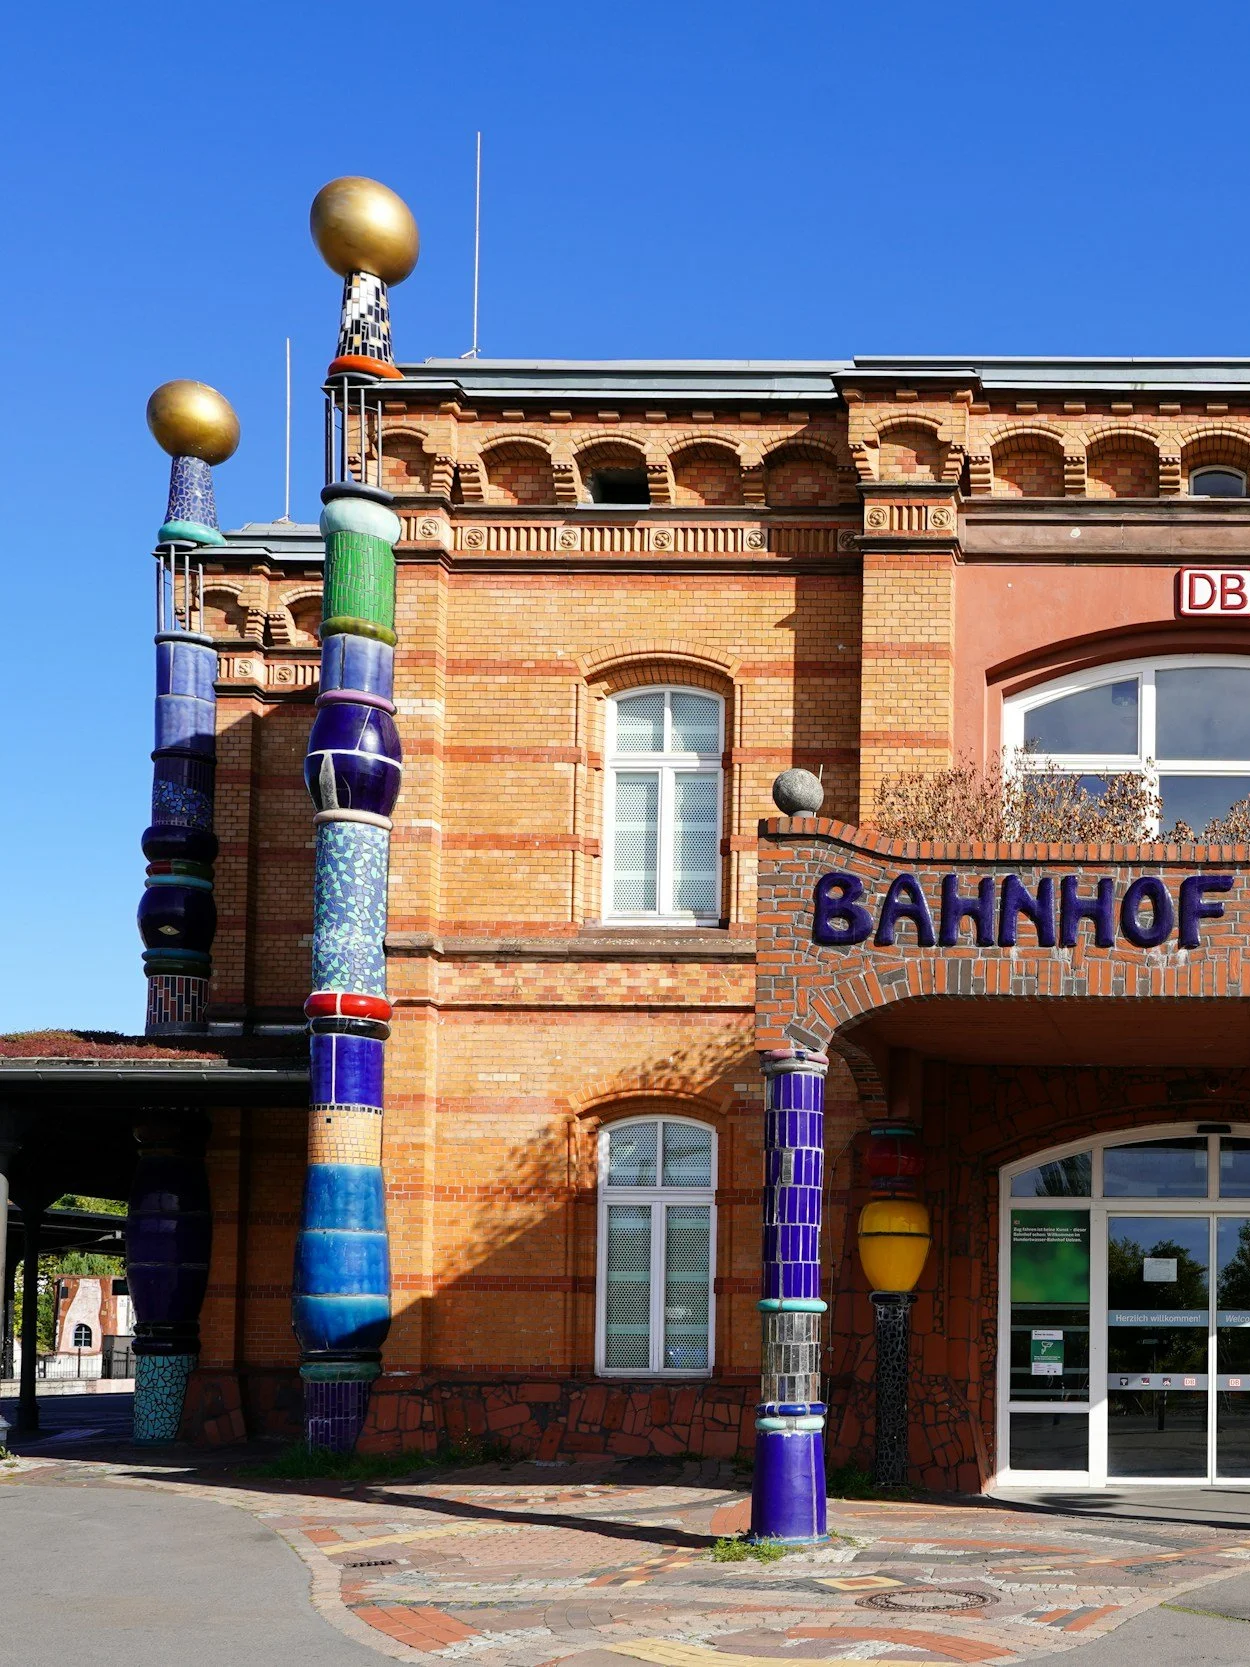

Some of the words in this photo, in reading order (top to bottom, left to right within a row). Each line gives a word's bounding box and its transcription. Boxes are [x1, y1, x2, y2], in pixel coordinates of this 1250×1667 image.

[1189, 573, 1248, 610] DB
[812, 873, 1235, 948] BAHNHOF
[1116, 1314, 1148, 1322] Herzlich
[1150, 1314, 1201, 1322] willkommen!
